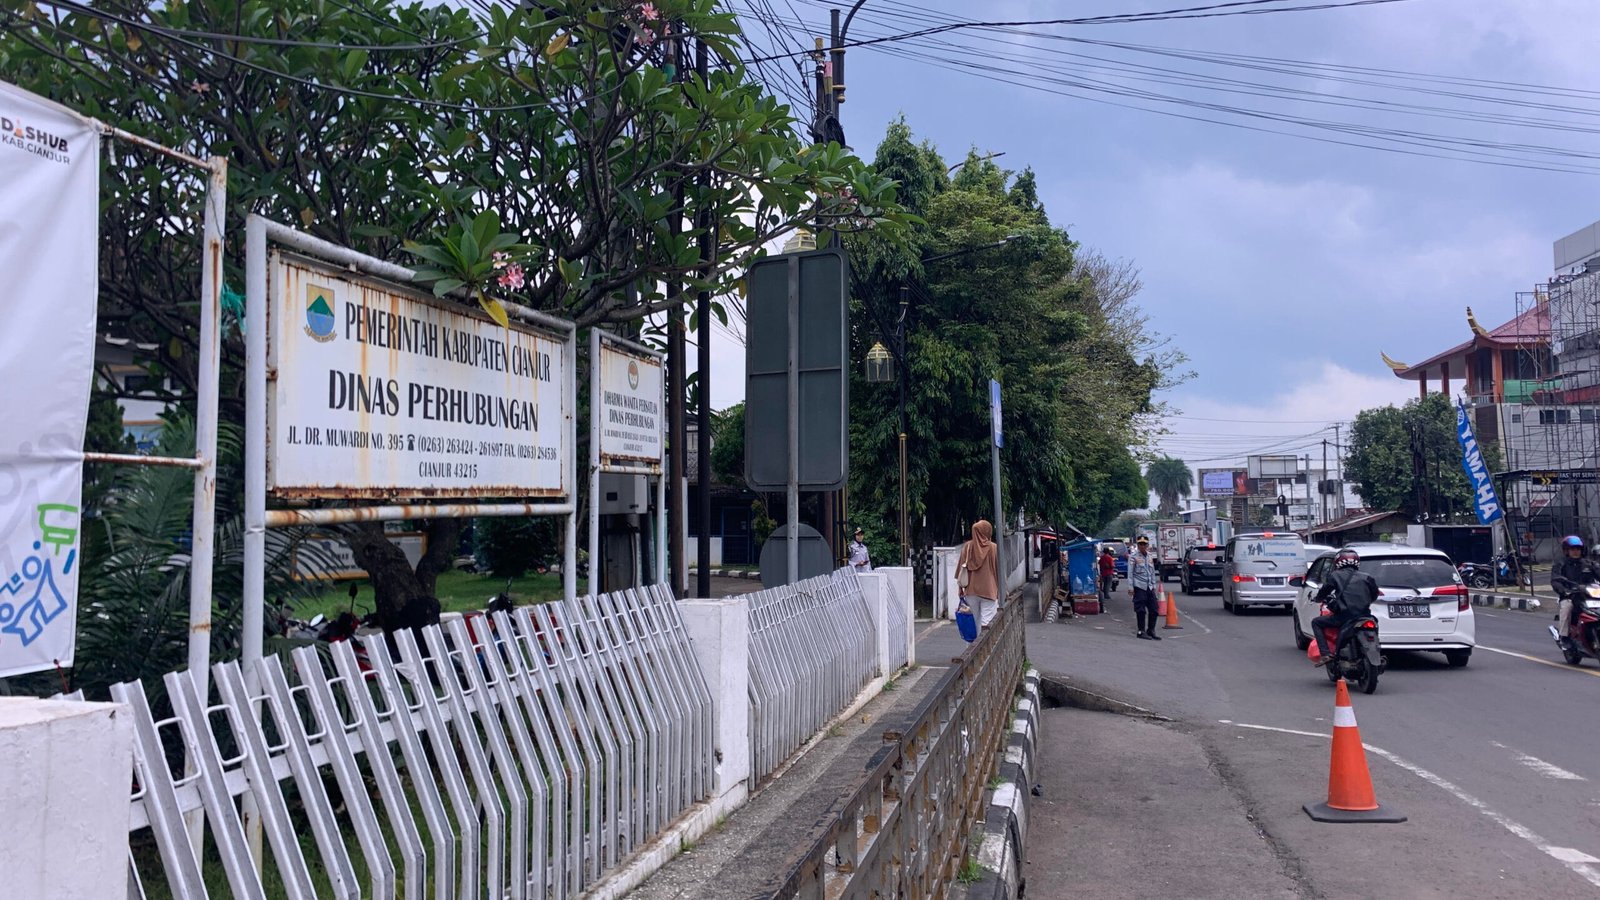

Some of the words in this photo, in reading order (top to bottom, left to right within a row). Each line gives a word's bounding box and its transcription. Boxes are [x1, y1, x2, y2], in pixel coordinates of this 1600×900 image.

[345, 301, 438, 358] PEMERINTAH
[442, 328, 509, 373] KABUPATEN
[511, 345, 551, 383] CIANJUR
[328, 369, 400, 416] DINAS
[407, 382, 539, 432] PERHUBUNGAN
[610, 408, 624, 424] DINAS
[287, 425, 302, 444] JL.
[305, 426, 323, 446] DR.
[326, 428, 369, 449] MUWARDI
[371, 432, 385, 450] NO.
[387, 433, 404, 450] 395
[417, 434, 445, 454] (0263)
[446, 437, 473, 455] 263424
[479, 440, 503, 457] 261897
[517, 444, 537, 460] (0263)
[418, 461, 452, 478] CIANJUR
[454, 463, 478, 479] 43215
[1461, 424, 1499, 520] YAMAHA
